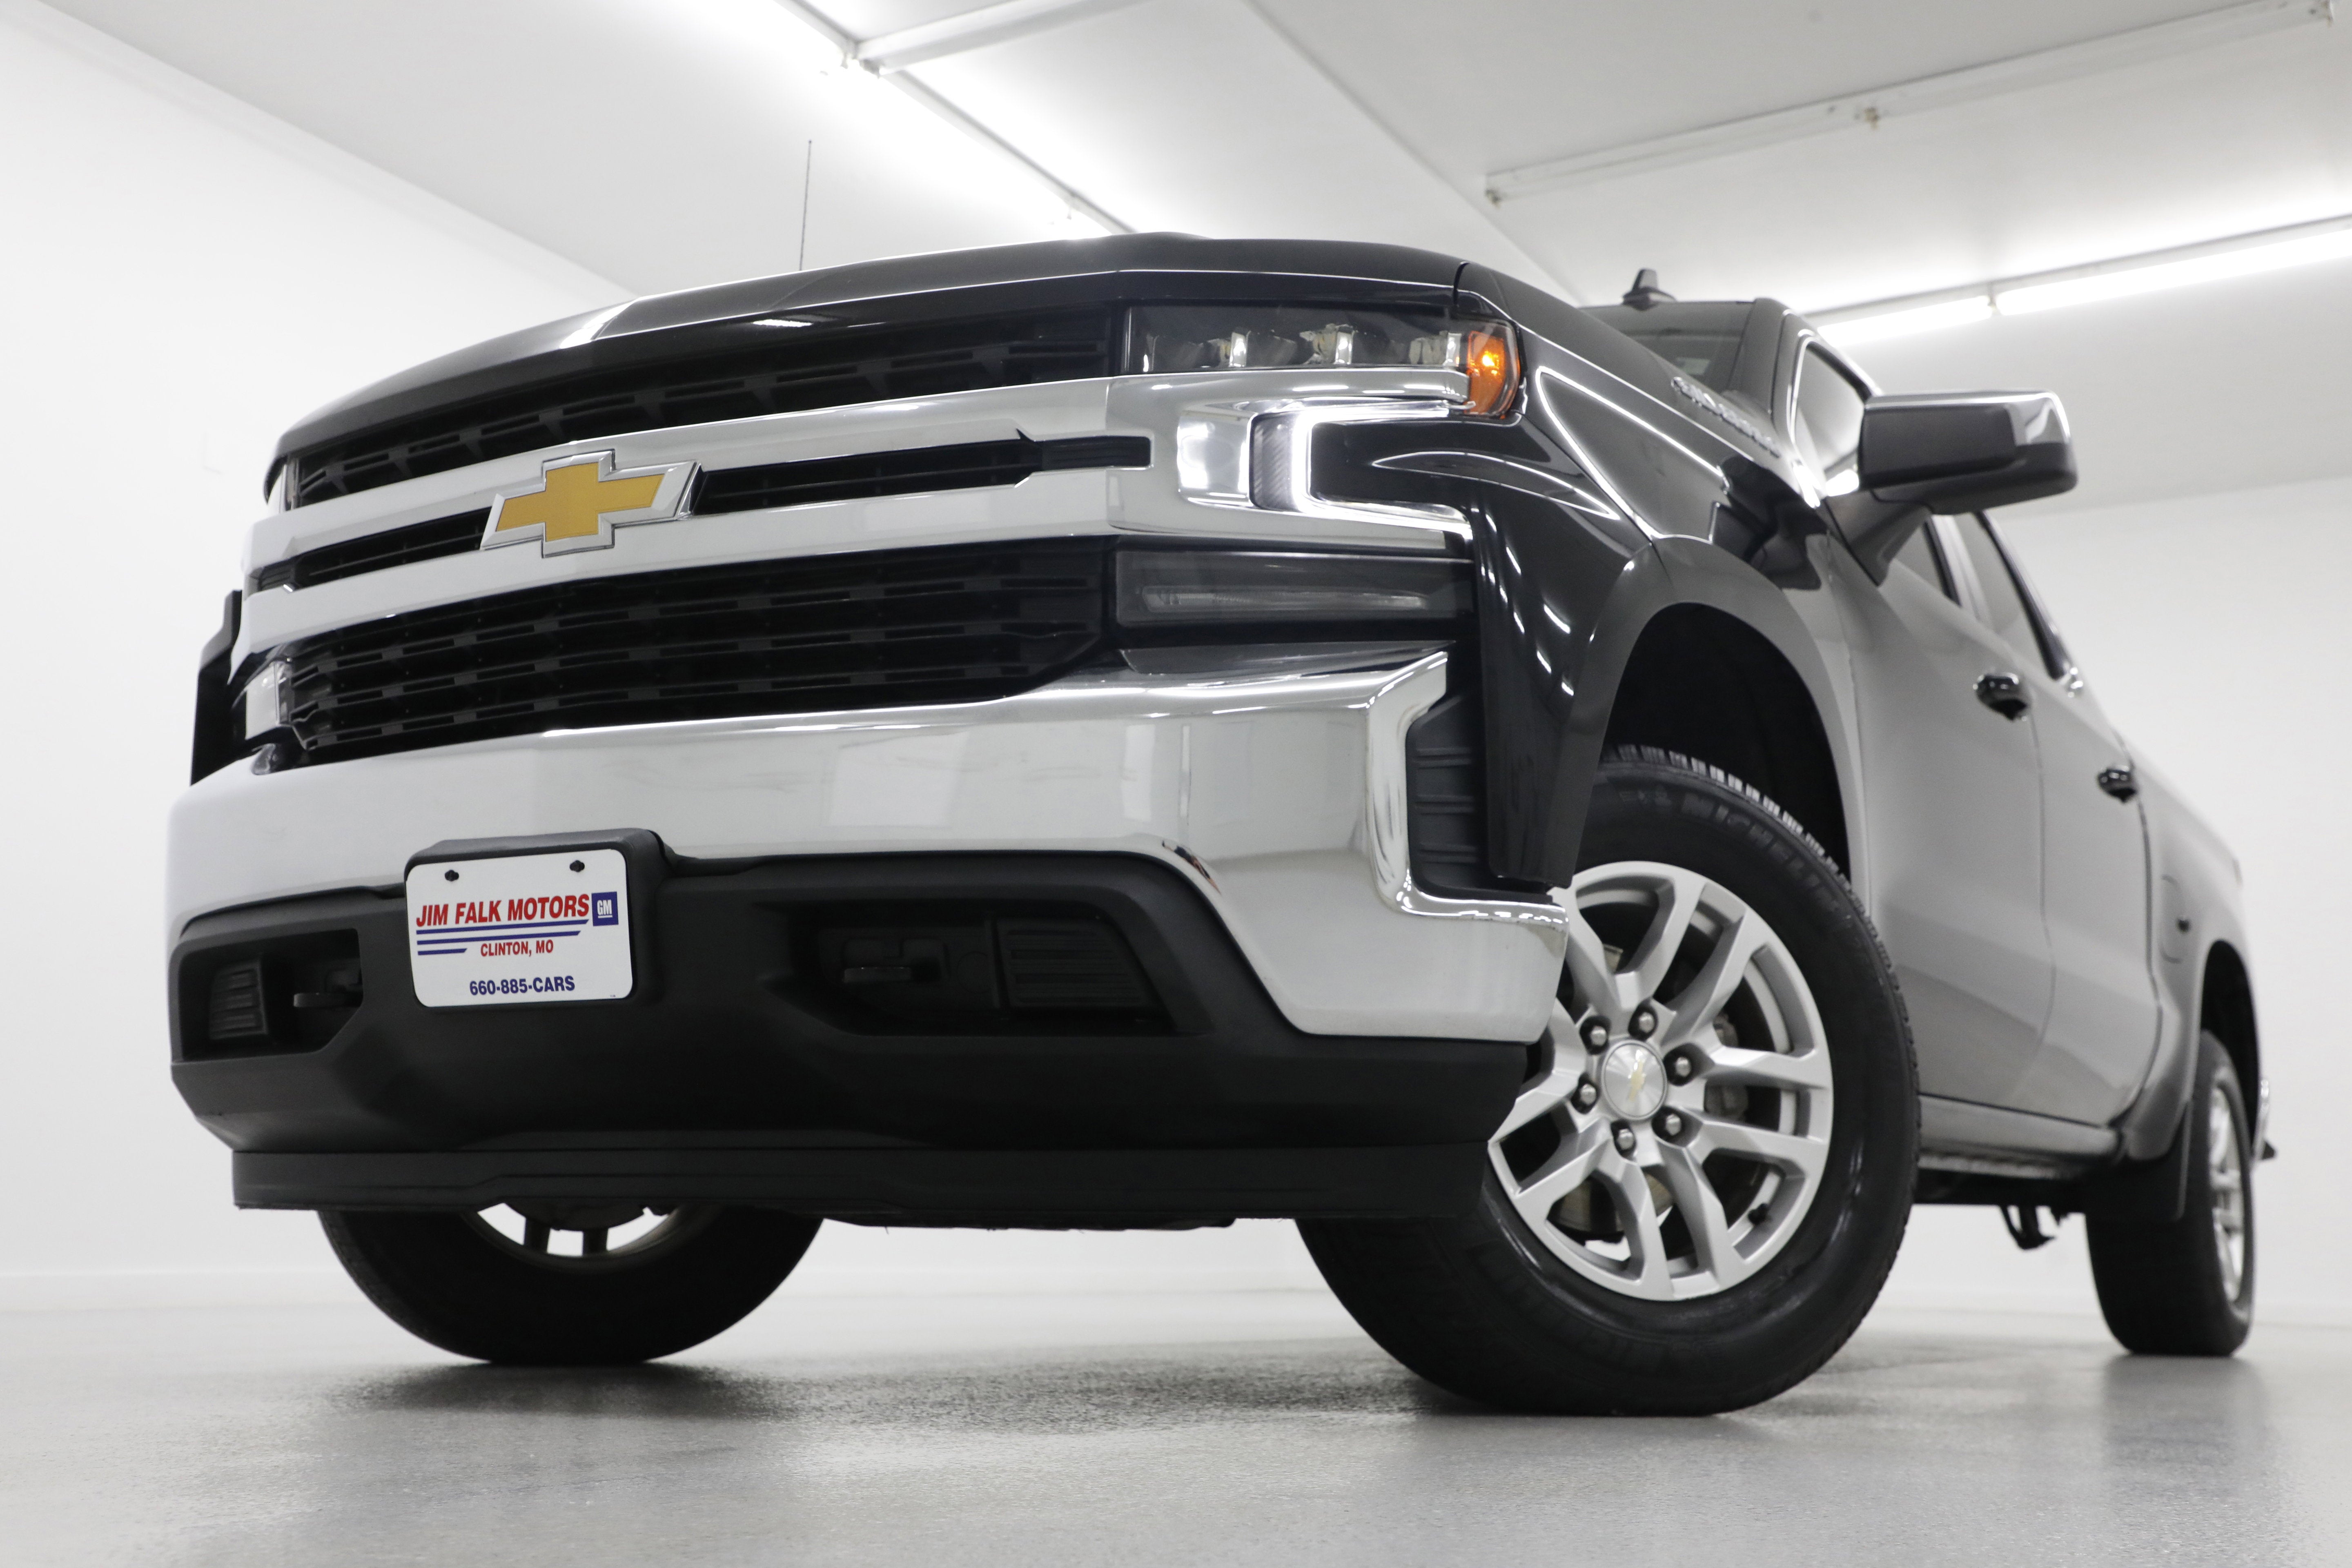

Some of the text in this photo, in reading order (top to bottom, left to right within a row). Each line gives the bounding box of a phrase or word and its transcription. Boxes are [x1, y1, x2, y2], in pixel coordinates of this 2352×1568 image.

[416, 894, 590, 927] JIM FALK MOTORS
[597, 899, 612, 915] GM
[481, 940, 554, 957] CLINTON, MO
[470, 976, 575, 996] 660-885-CARS
